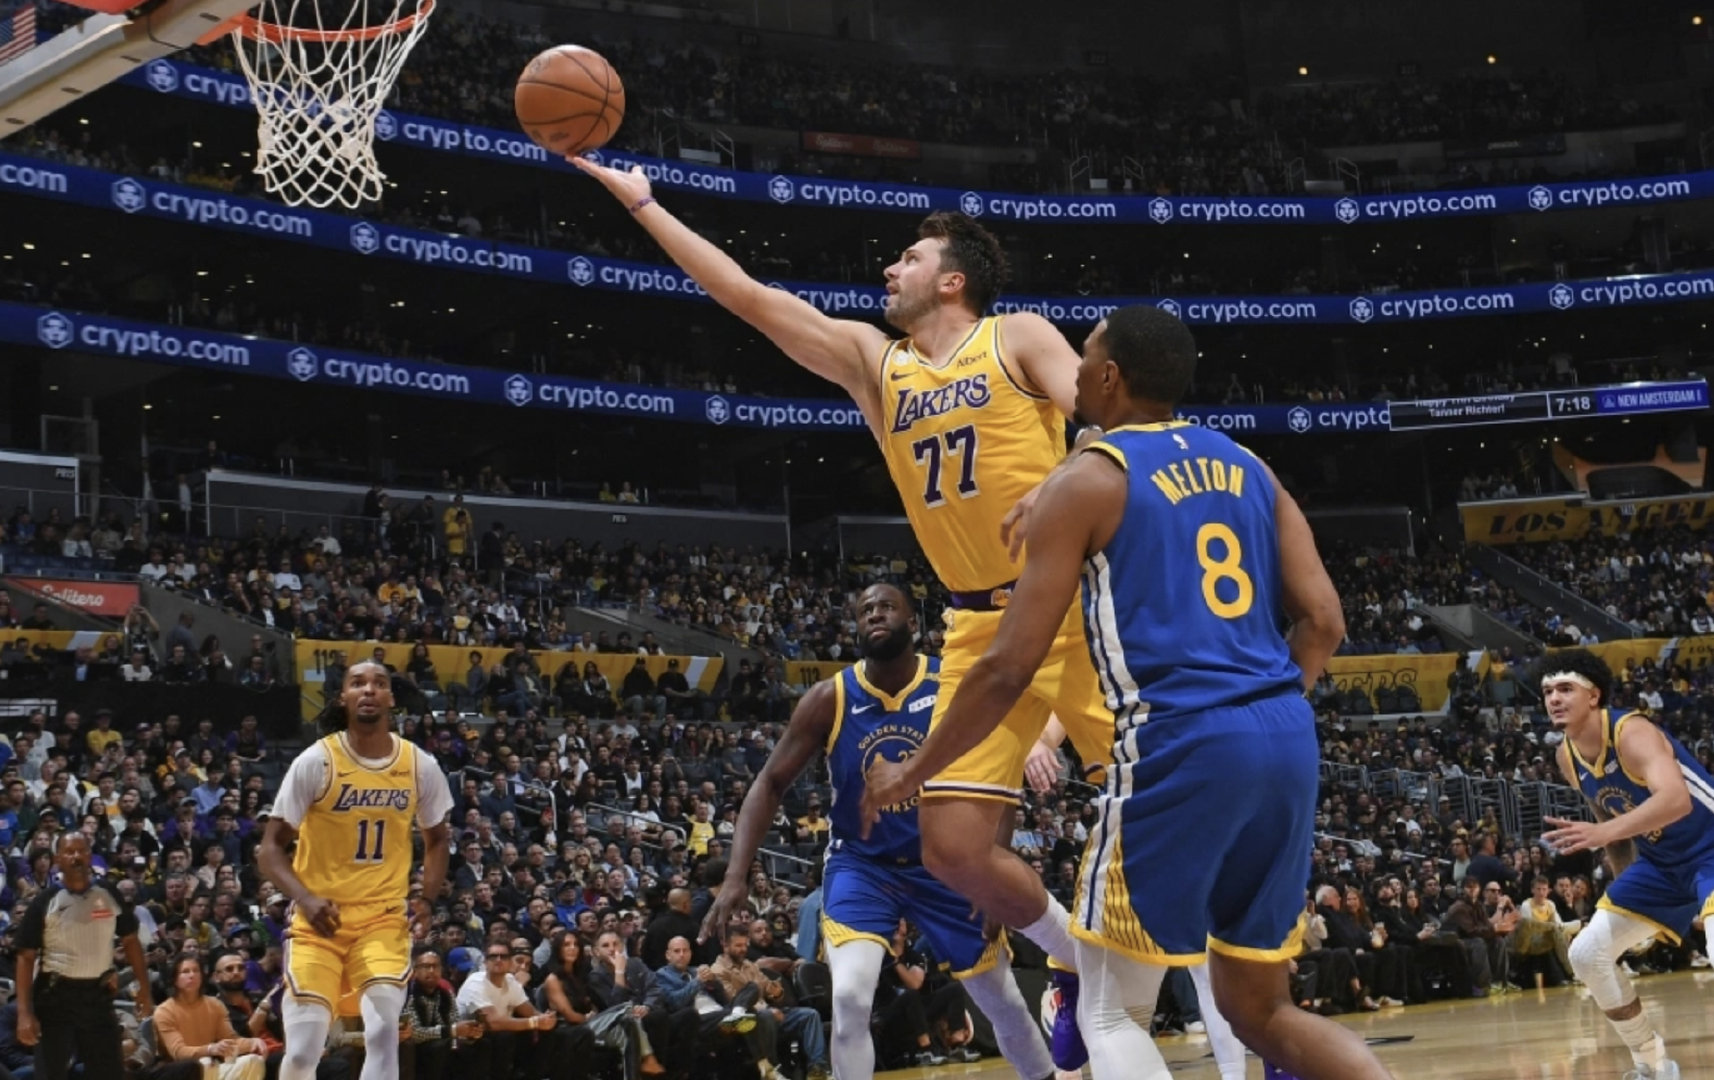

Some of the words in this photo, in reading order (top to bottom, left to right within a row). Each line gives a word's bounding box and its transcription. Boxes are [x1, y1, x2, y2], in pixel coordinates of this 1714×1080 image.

[403, 122, 548, 161] crypto.com
[610, 159, 736, 193] crpto.com
[800, 183, 930, 209] crypto.com
[1365, 193, 1496, 217] crypto.com
[1558, 180, 1690, 205] crypto.com
[153, 191, 312, 236] crypto.com
[990, 199, 1116, 219] crypto.com
[1179, 200, 1305, 221] crypto.com
[385, 234, 532, 272] crypto.com
[1380, 292, 1514, 317] crypto.com
[1580, 278, 1714, 304] crypto.com
[1188, 301, 1316, 322] crypto.com
[81, 323, 251, 366] crypto.com
[325, 359, 470, 393] crypto.com
[539, 384, 674, 413] crypto.com
[891, 373, 991, 434] LAKERS
[1556, 396, 1591, 412] 7:18
[1617, 394, 1638, 408] NEW
[911, 423, 980, 510] 77
[1150, 457, 1244, 506] MELTON
[1489, 510, 1567, 535] LOS
[1196, 522, 1254, 619] 8
[858, 724, 897, 750] GOLDEN
[899, 725, 927, 742] STAT
[331, 783, 413, 812] LAKERS
[354, 818, 387, 864] 11
